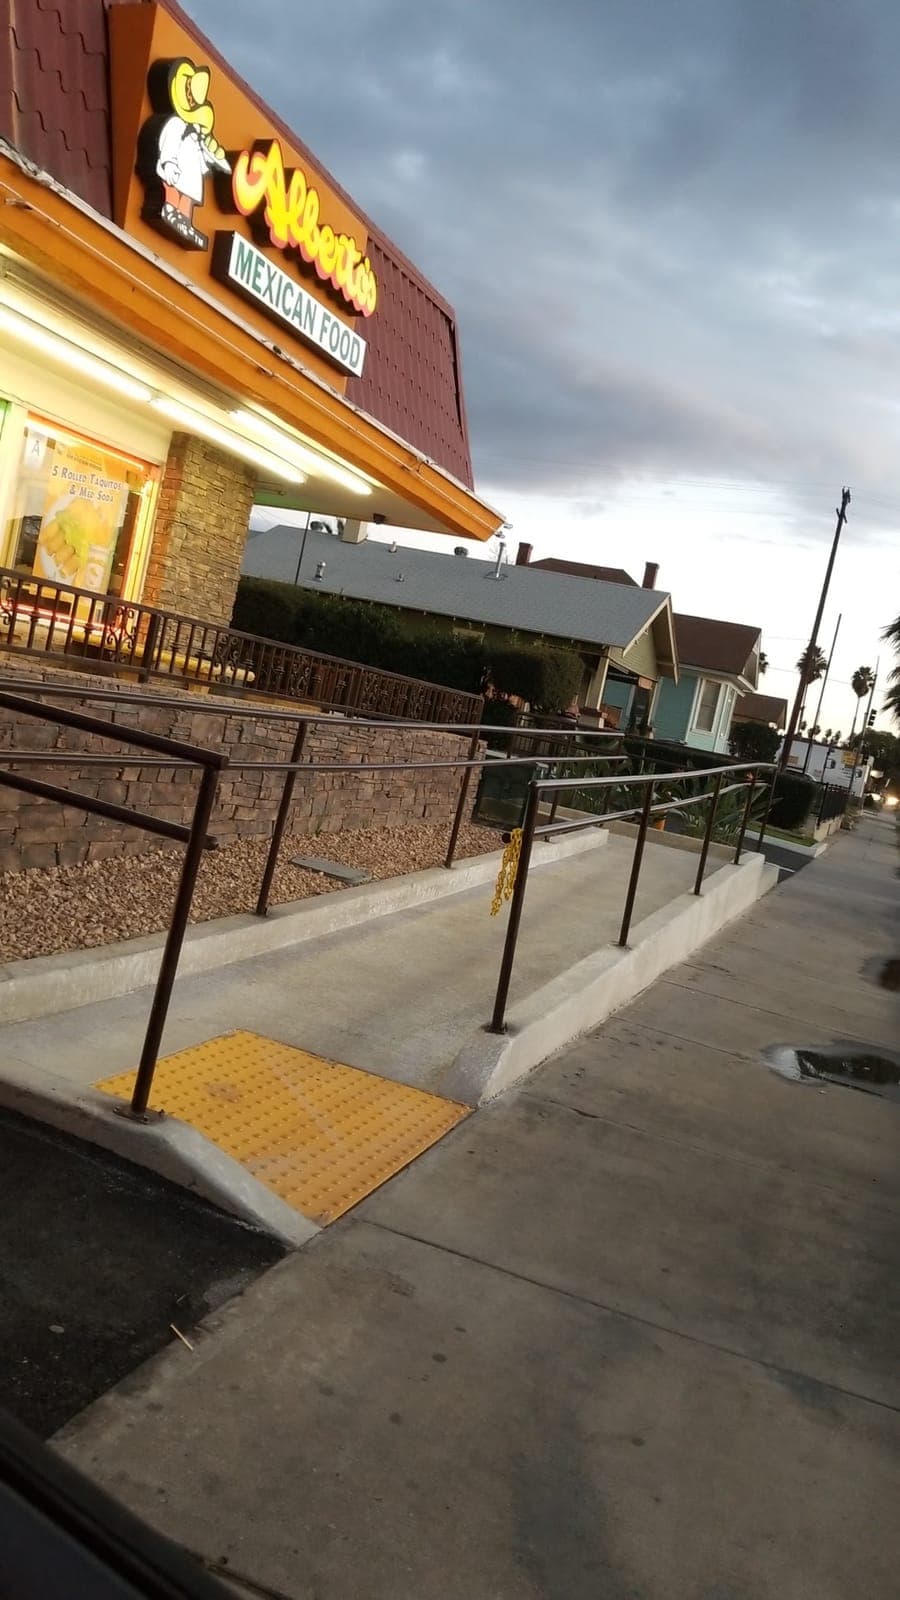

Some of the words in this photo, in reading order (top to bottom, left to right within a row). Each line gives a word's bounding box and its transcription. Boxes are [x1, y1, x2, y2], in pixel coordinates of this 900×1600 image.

[235, 241, 317, 336] MEXICAN
[320, 311, 361, 368] FOOD
[32, 440, 41, 456] A
[69, 484, 76, 495] &
